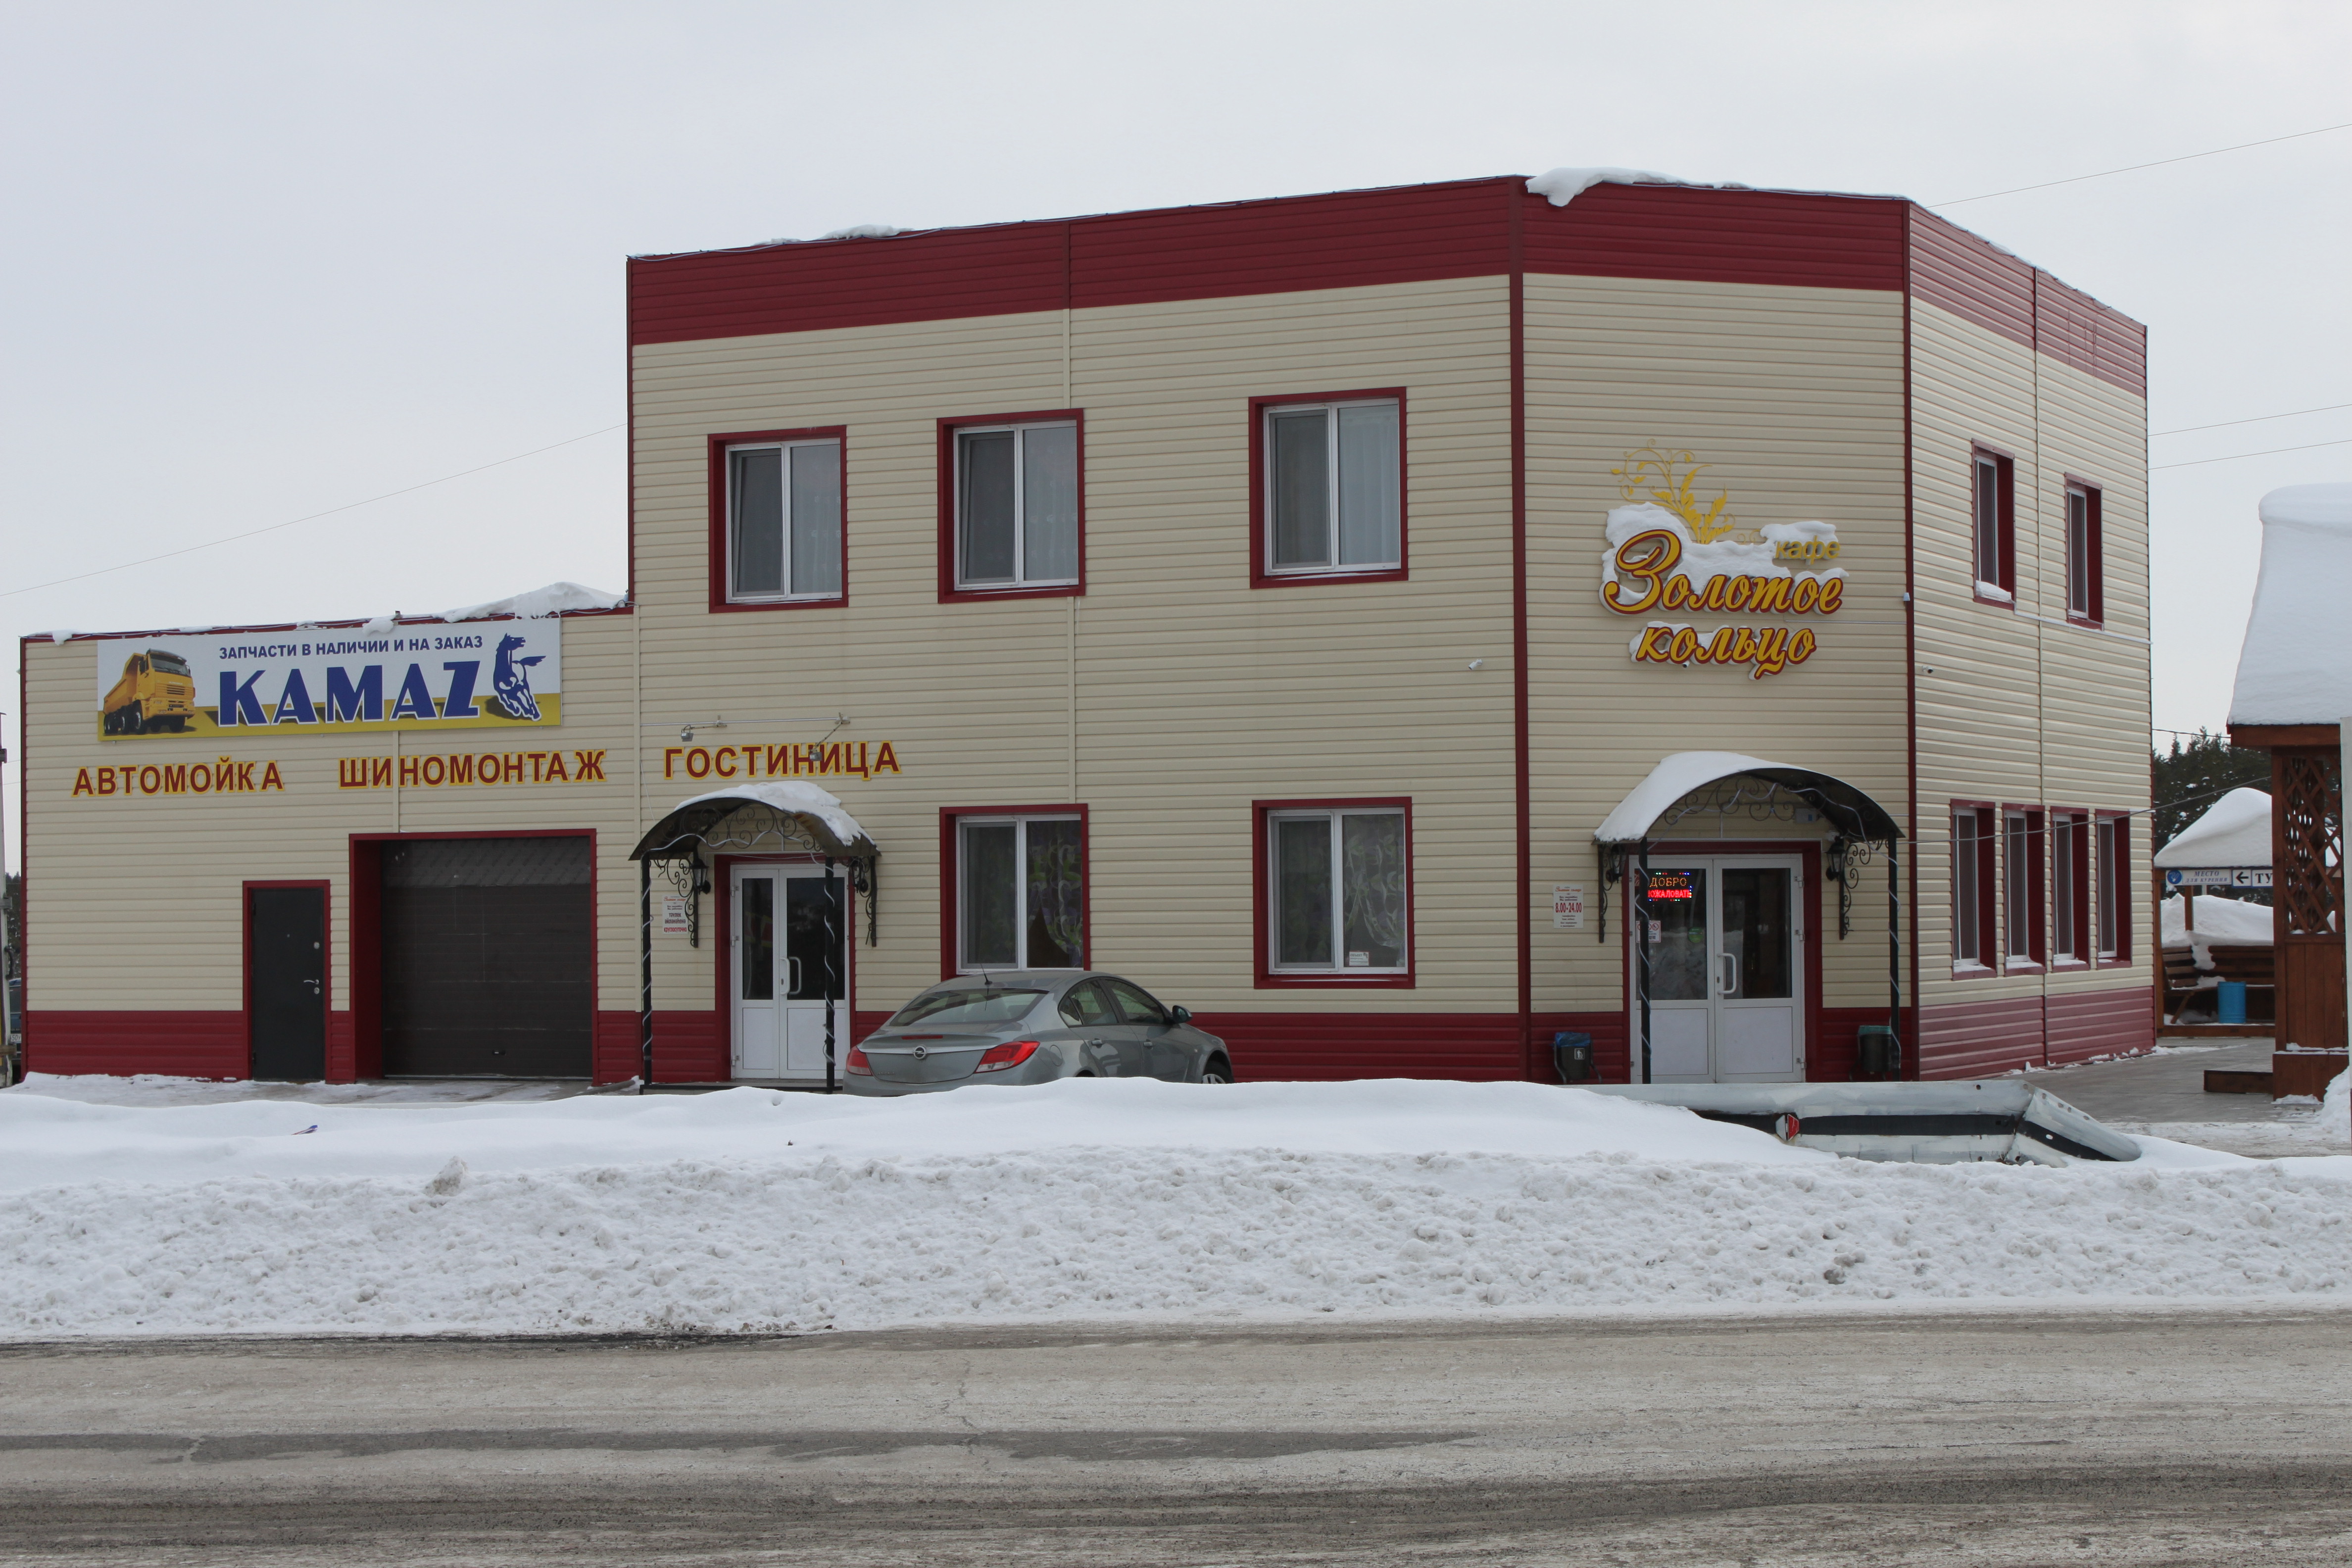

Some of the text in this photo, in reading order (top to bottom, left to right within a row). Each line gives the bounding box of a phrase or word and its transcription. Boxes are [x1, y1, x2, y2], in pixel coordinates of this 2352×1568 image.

[1775, 535, 1841, 565] кафе
[1603, 529, 1843, 615] Золотое
[219, 636, 483, 659] ЗАПЧАСТИ В НАЛИЧИИ И НА ЗАКАЗ
[1635, 627, 1817, 681] кольцо
[218, 659, 481, 727] KAMAZ
[71, 755, 285, 797] АВТОМОЙКА
[338, 748, 608, 790] ШИНОМОНТАЖ
[663, 740, 902, 782] ГОСТИНИЦА
[1649, 878, 1687, 887] ДОБРО
